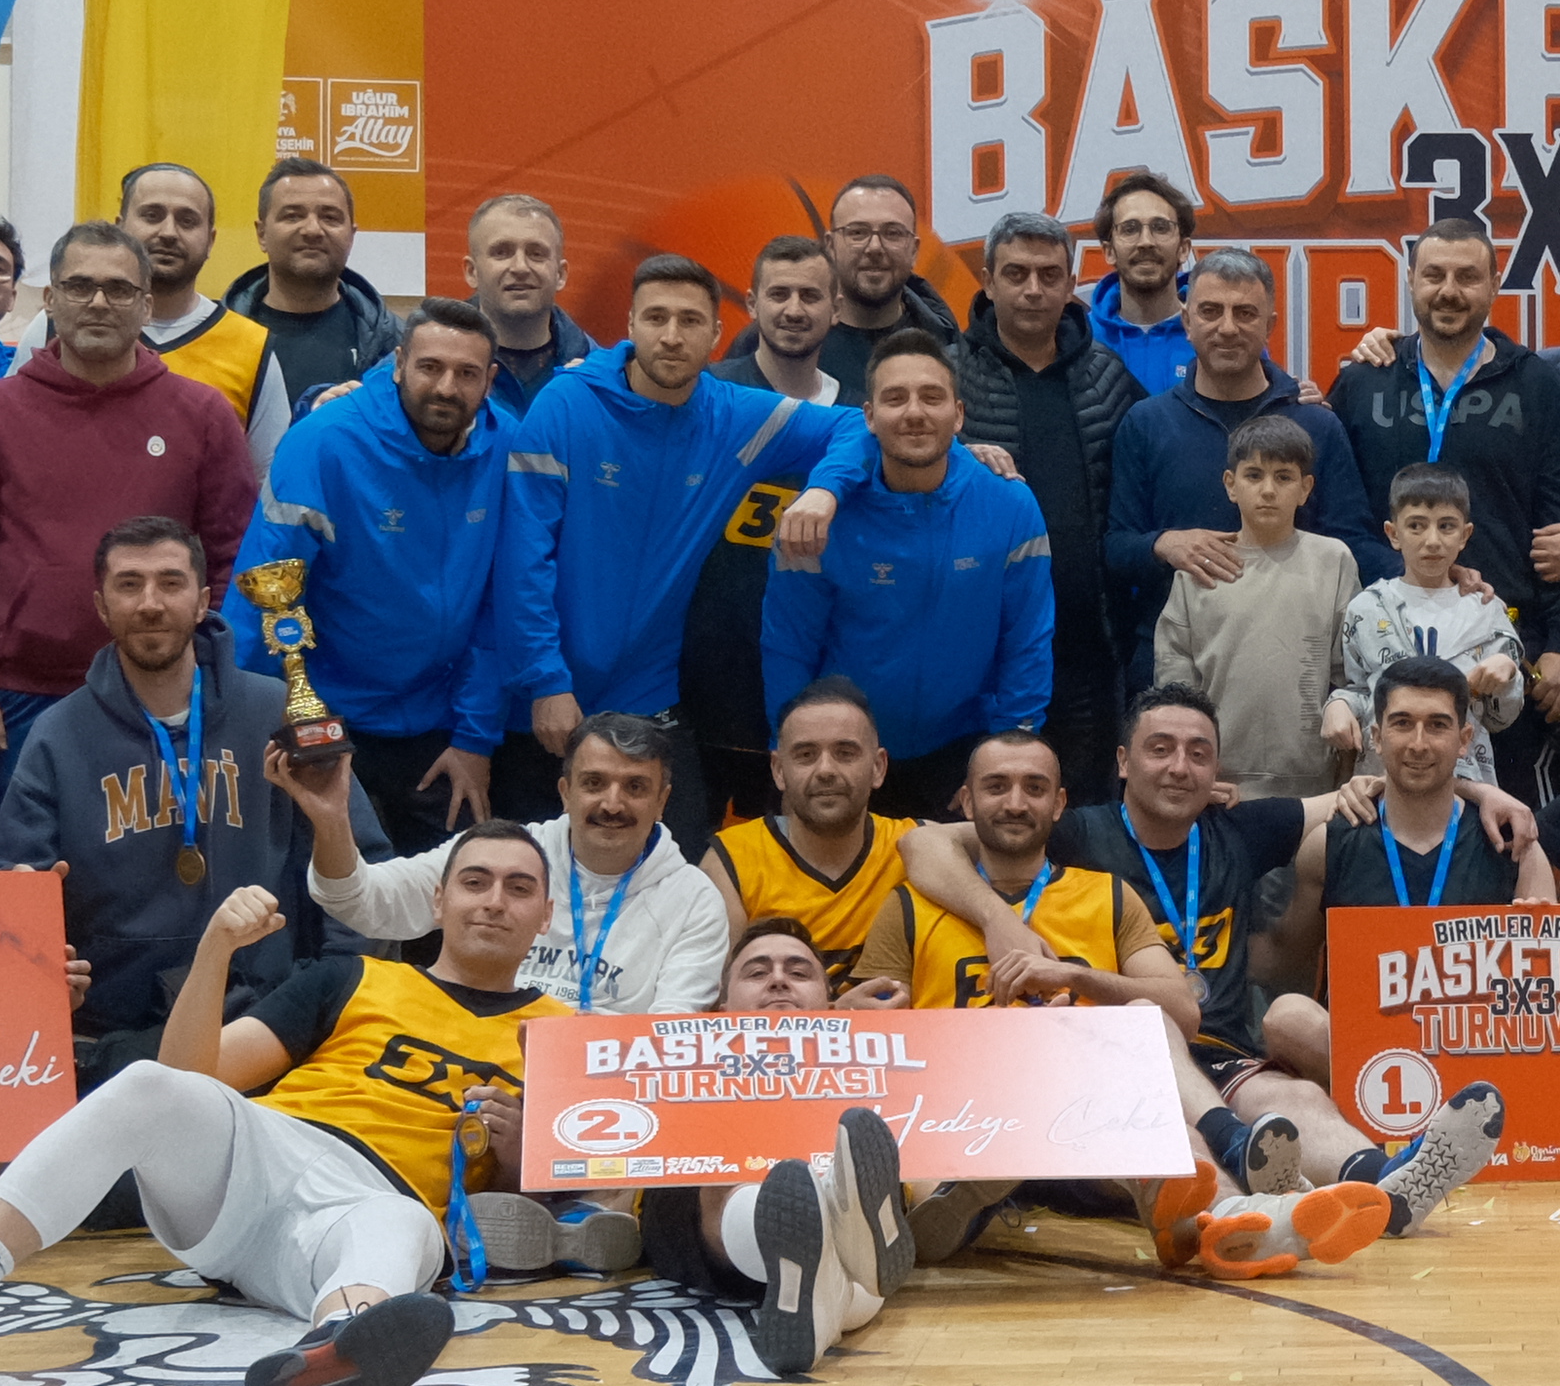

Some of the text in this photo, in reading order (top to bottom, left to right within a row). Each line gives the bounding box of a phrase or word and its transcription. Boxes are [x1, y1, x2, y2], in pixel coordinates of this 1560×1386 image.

[334, 117, 413, 156] Altay
[1490, 976, 1557, 1017] 3X3
[778, 1018, 851, 1033] ARASI
[585, 1029, 927, 1075] BASKETBOL
[718, 1053, 797, 1078] 3X3
[625, 1067, 889, 1103] TURNUVASI
[1381, 1064, 1421, 1115] 1.
[576, 1109, 639, 1142] 2.
